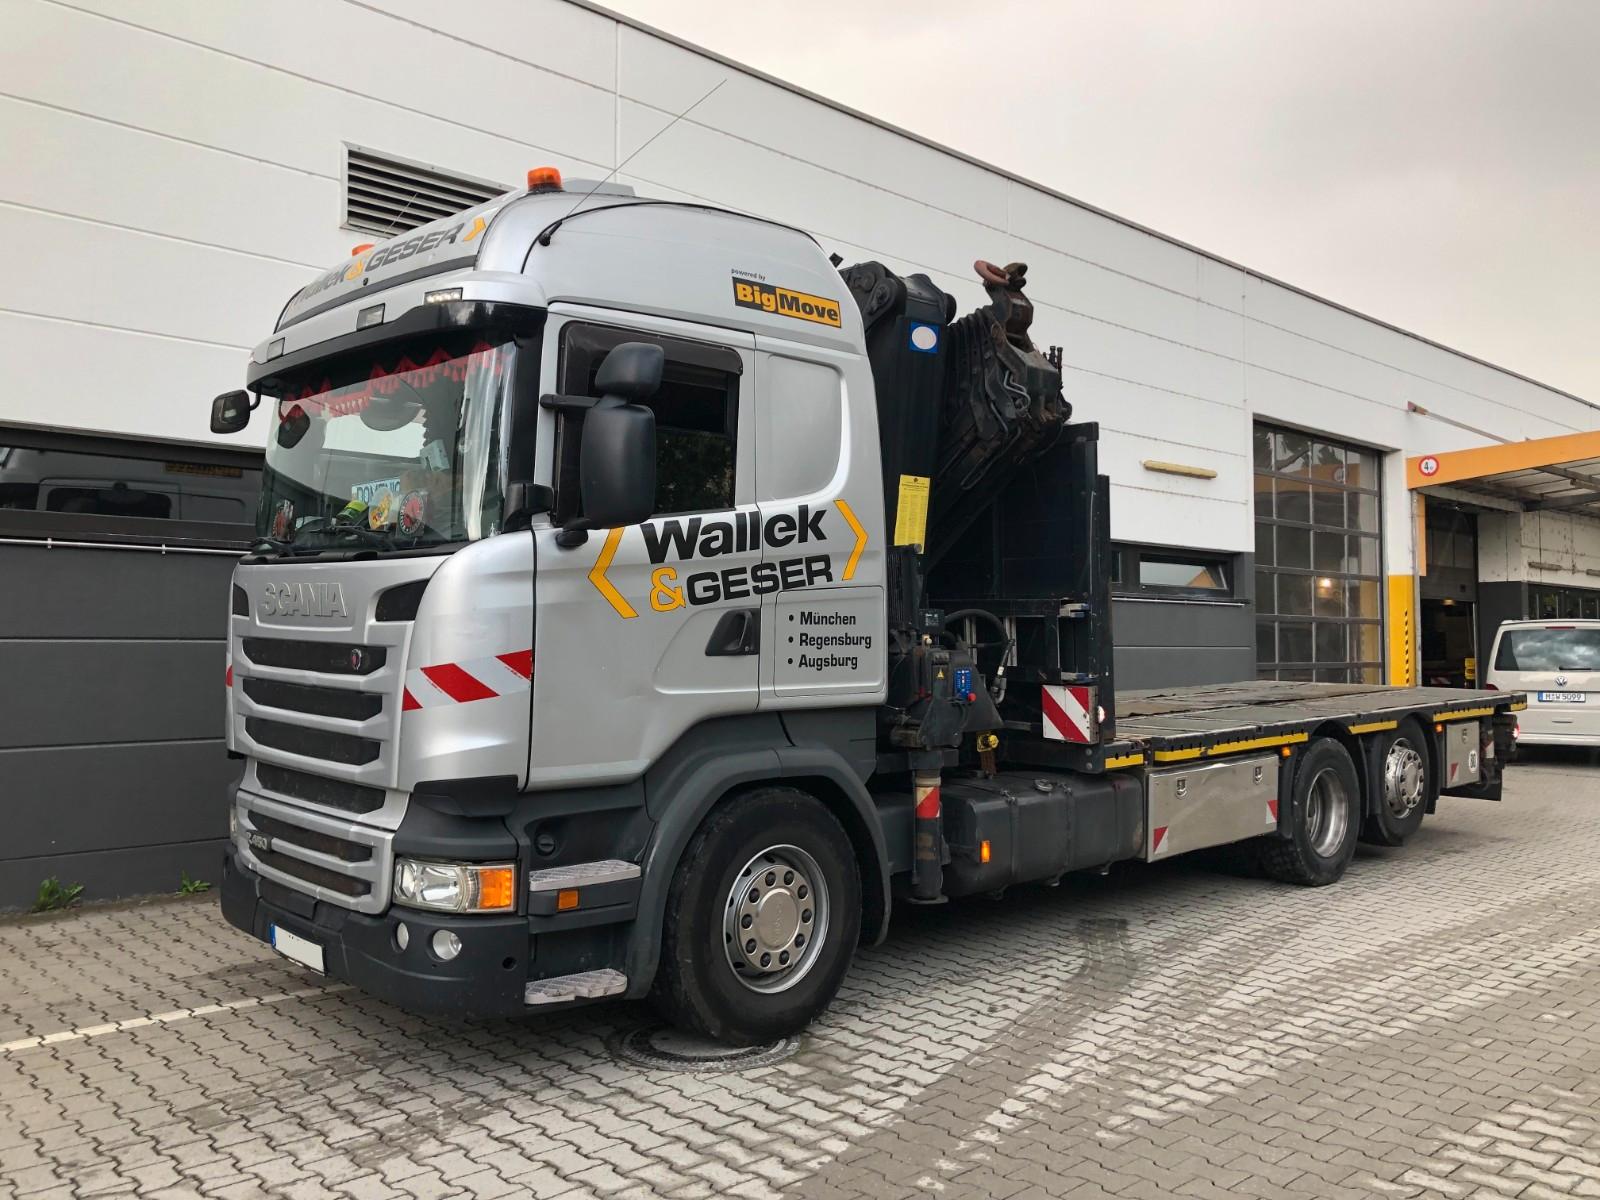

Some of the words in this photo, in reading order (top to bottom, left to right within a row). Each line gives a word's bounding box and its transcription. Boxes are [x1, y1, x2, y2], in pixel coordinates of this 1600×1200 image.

[731, 268, 757, 278] powered
[759, 273, 766, 281] by
[736, 282, 839, 321] BigMove
[640, 505, 827, 564] Wallek
[264, 582, 347, 617] SCANIA
[800, 611, 856, 625] München
[799, 633, 872, 650] Regensburg
[799, 653, 858, 671] Augsburg
